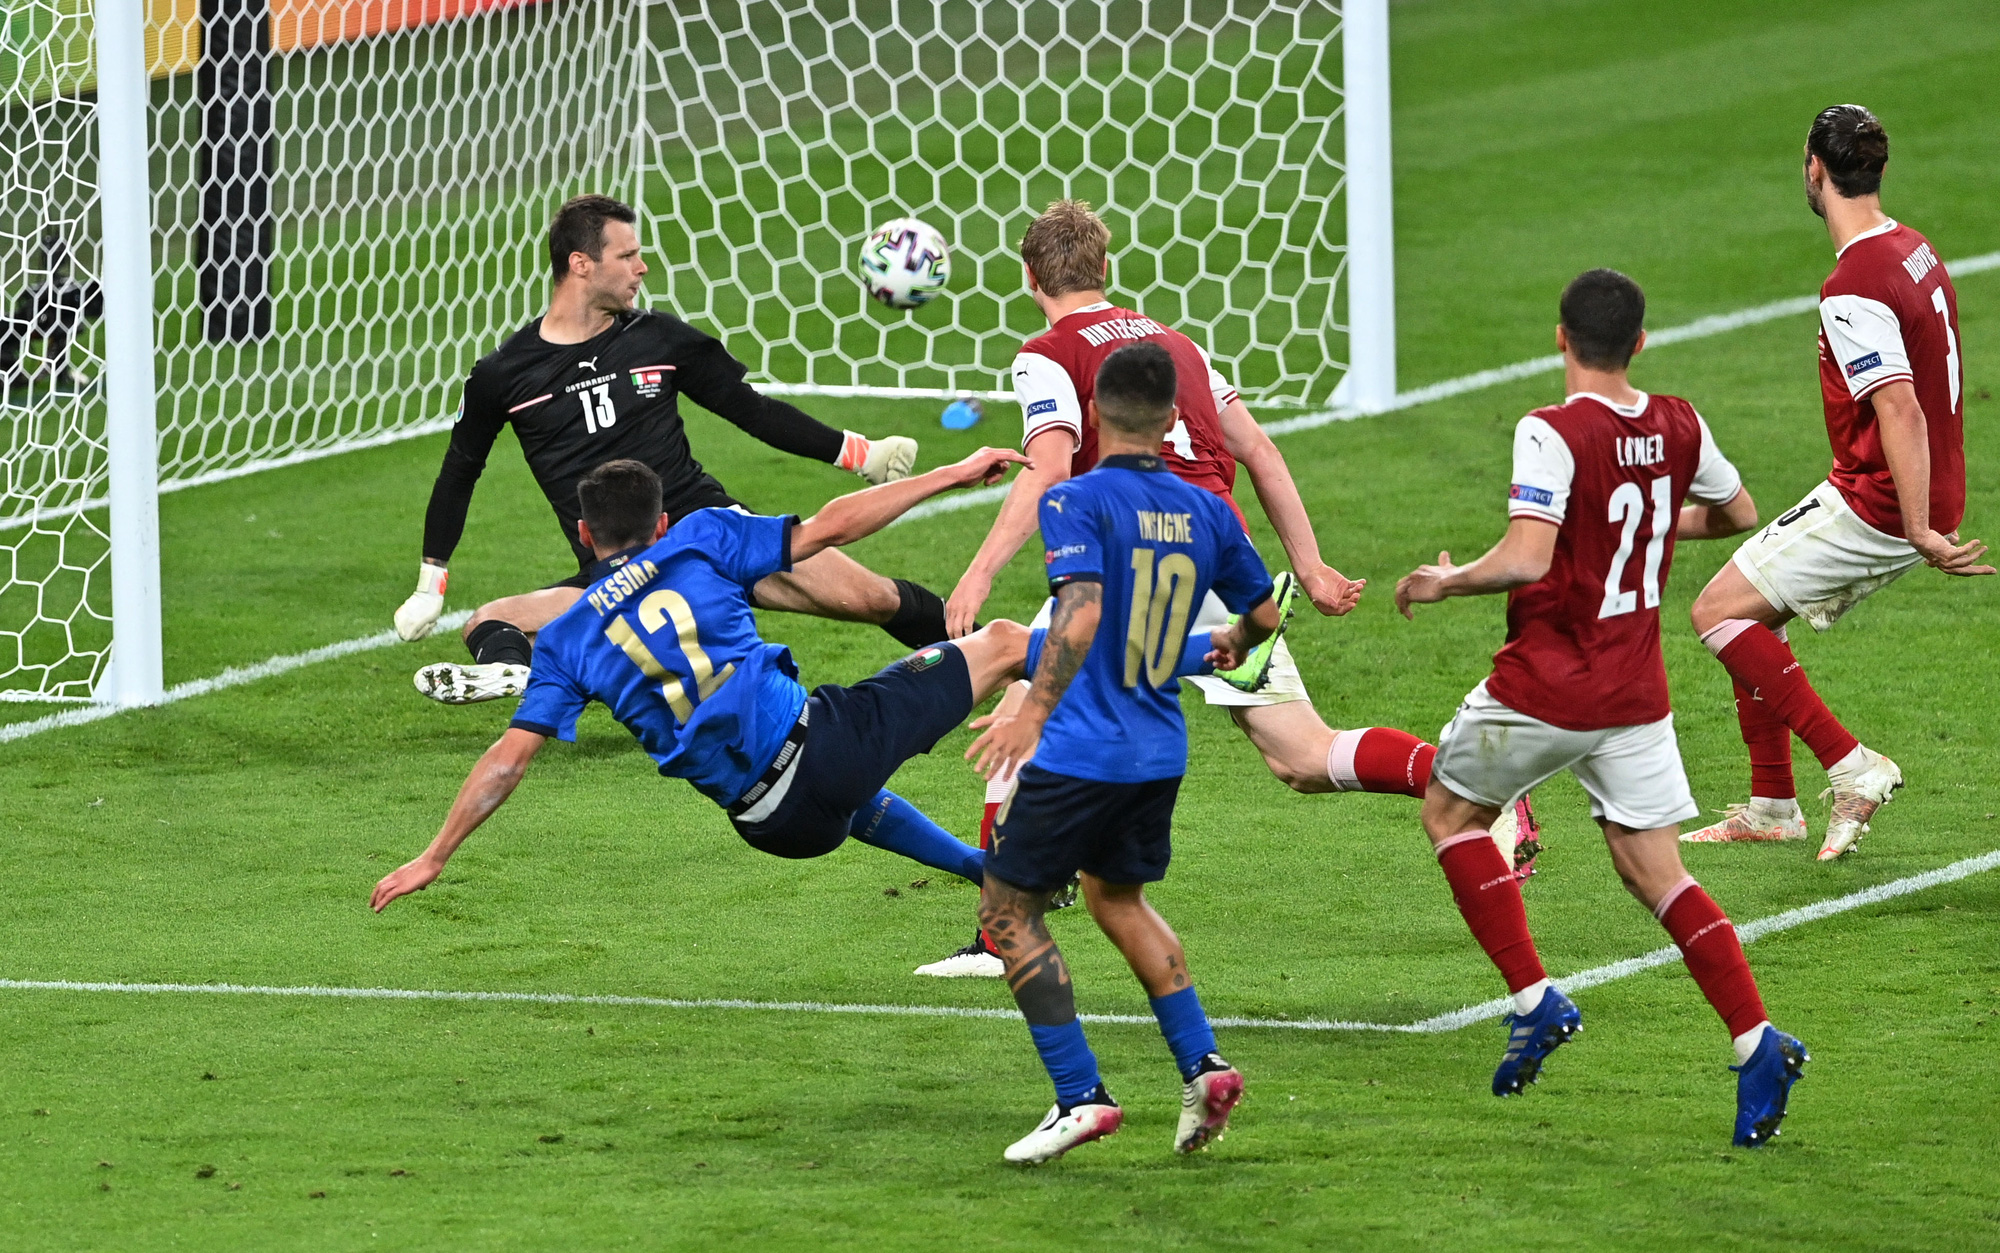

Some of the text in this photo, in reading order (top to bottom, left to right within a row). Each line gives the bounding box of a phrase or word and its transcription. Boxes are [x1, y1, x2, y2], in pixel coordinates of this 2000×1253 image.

[1853, 355, 1880, 371] RESPECT
[578, 383, 617, 434] 13
[1028, 402, 1056, 414] ESPECT
[1519, 487, 1552, 504] RESPECT
[1777, 497, 1821, 527] 3
[1053, 544, 1087, 558] RESPECT
[1597, 475, 1671, 619] 21
[587, 560, 660, 617] PESSINA
[1123, 547, 1197, 689] 10
[604, 589, 736, 725] 12
[772, 740, 798, 771] PUMA
[741, 781, 769, 805] PUMA
